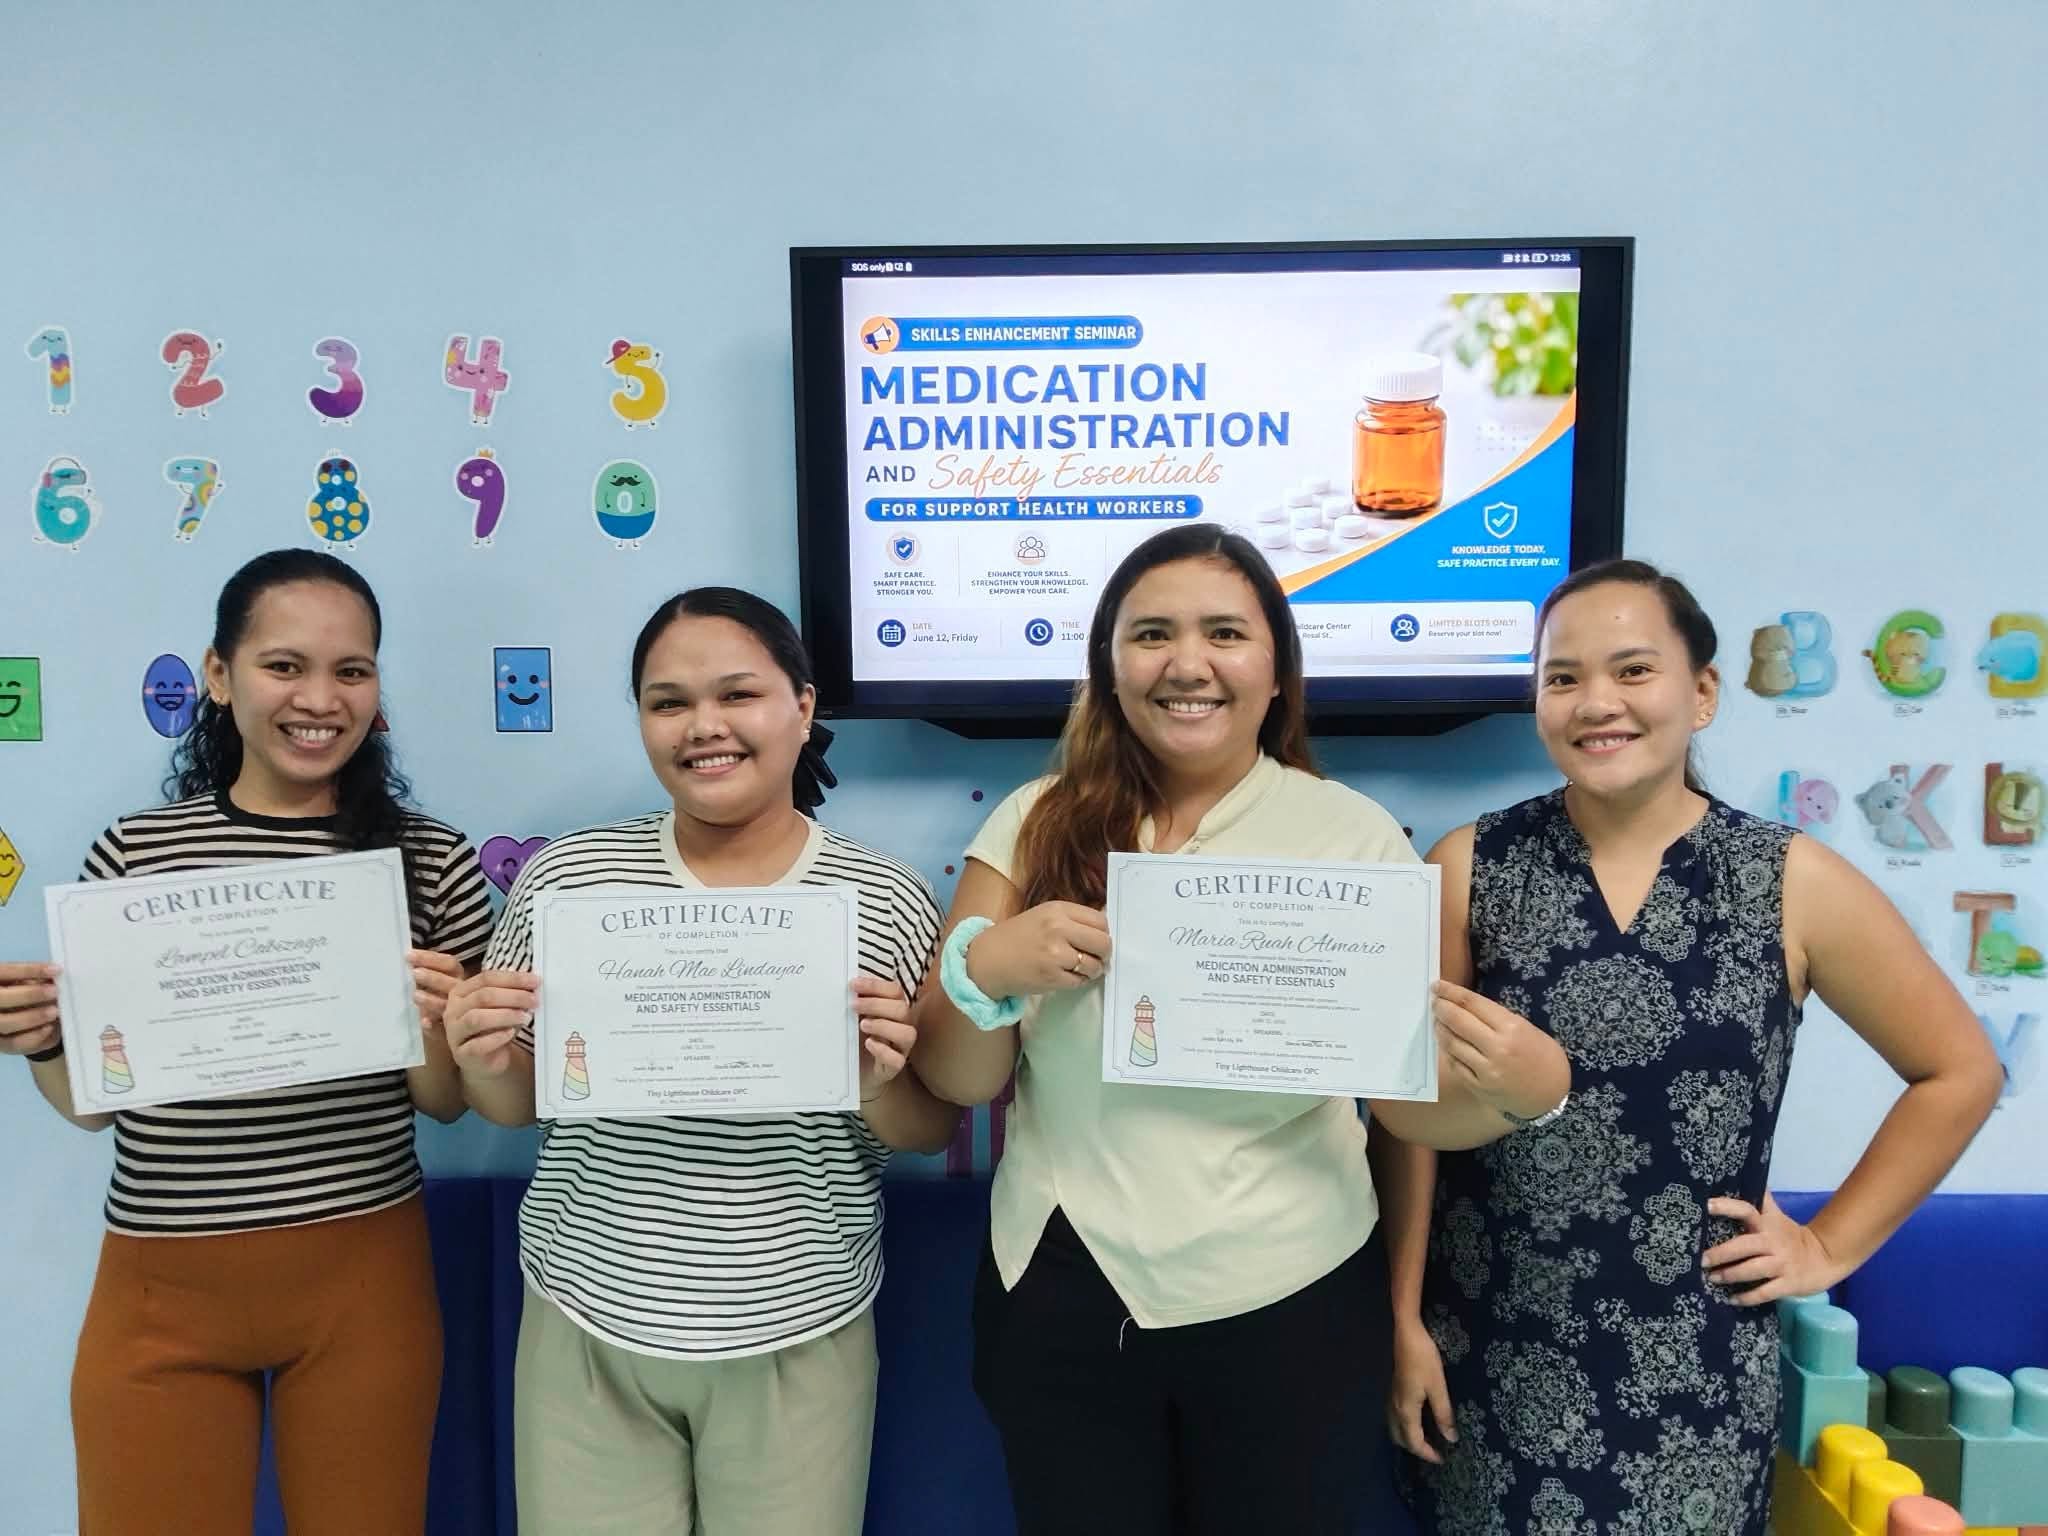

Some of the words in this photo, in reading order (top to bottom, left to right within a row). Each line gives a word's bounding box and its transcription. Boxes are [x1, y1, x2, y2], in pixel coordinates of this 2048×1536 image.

[851, 262, 868, 272] SOS
[869, 262, 886, 273] only
[911, 327, 960, 342] SKILLS
[965, 326, 1070, 342] ENHANCEMENT
[1074, 326, 1137, 341] SEMINAR
[28, 328, 71, 406] 1
[162, 332, 224, 409] 2
[308, 338, 365, 419] 3
[446, 336, 508, 418] 4
[611, 343, 667, 422] 5
[860, 362, 1207, 405] MEDICATION
[863, 411, 1290, 451] ADMINISTRATION
[865, 465, 917, 483] AND
[928, 453, 1046, 502] Safety
[1053, 452, 1224, 490] Essentials
[36, 467, 90, 545] 6
[166, 459, 218, 534] 7
[308, 457, 370, 543] 8
[456, 458, 506, 539] 9
[881, 503, 917, 517] FOR
[925, 502, 1010, 517] SUPPORT
[1018, 501, 1089, 516] HEALTH
[1096, 500, 1187, 515] WORKERS
[1452, 546, 1511, 555] KNOWLEDGE
[1437, 559, 1460, 568] SAFE
[1462, 558, 1508, 568] PRACTICE
[1510, 558, 1540, 567] EVERY
[1541, 558, 1561, 567] DAY.
[884, 571, 902, 579] SAFE
[1022, 570, 1044, 578] YOUR
[876, 588, 914, 596] STRONGER
[916, 588, 934, 596] YOU.
[1326, 622, 1352, 630] Center
[1428, 620, 1462, 628] LIMITED
[1464, 619, 1490, 627] SLOTS
[912, 634, 934, 642] June
[936, 634, 950, 644] 12,
[952, 634, 978, 644] Friday
[1062, 632, 1084, 641] 11:00
[1428, 630, 1455, 638] Reserve
[1456, 631, 1471, 639] your
[1873, 609, 1947, 698] C
[1174, 874, 1373, 908] CERTIFICATE
[122, 880, 337, 924] CERTIFICATE
[1232, 901, 1245, 910] OF
[1250, 902, 1314, 912] COMPLETION
[208, 907, 279, 922] COMPLETION
[600, 904, 794, 933] CERTIFICATE
[658, 932, 672, 940] OF
[676, 931, 738, 940] COMPLETION
[1168, 926, 1236, 948] Maria
[1240, 930, 1294, 950] Ruah
[1297, 932, 1386, 954] Almario
[598, 959, 665, 981] Hanah
[669, 960, 716, 978] Mae
[721, 957, 806, 981] Lindayao
[1196, 960, 1259, 973] MEDICATION
[1262, 963, 1346, 977] ADMINISTRATION
[158, 972, 230, 991] MEDICATION
[232, 962, 321, 982] ADMINISTRATION
[1208, 973, 1230, 984] AND
[1232, 974, 1272, 985] SAFETY
[1275, 976, 1336, 988] ESSENTIALS
[174, 989, 200, 1000] AND
[202, 982, 245, 996] SAFETY
[247, 974, 312, 991] ESSENTIALS
[624, 992, 686, 1003] MEDICATION
[690, 990, 771, 1002] ADMINISTRATION
[636, 1004, 658, 1014] AND
[662, 1004, 699, 1014] SAFETY
[703, 1002, 761, 1012] ESSENTIALS
[1216, 1062, 1230, 1072] Tiny
[1232, 1063, 1270, 1073] Lighthouse
[648, 1090, 661, 1098] Tiny
[701, 1088, 731, 1096] Childcare
